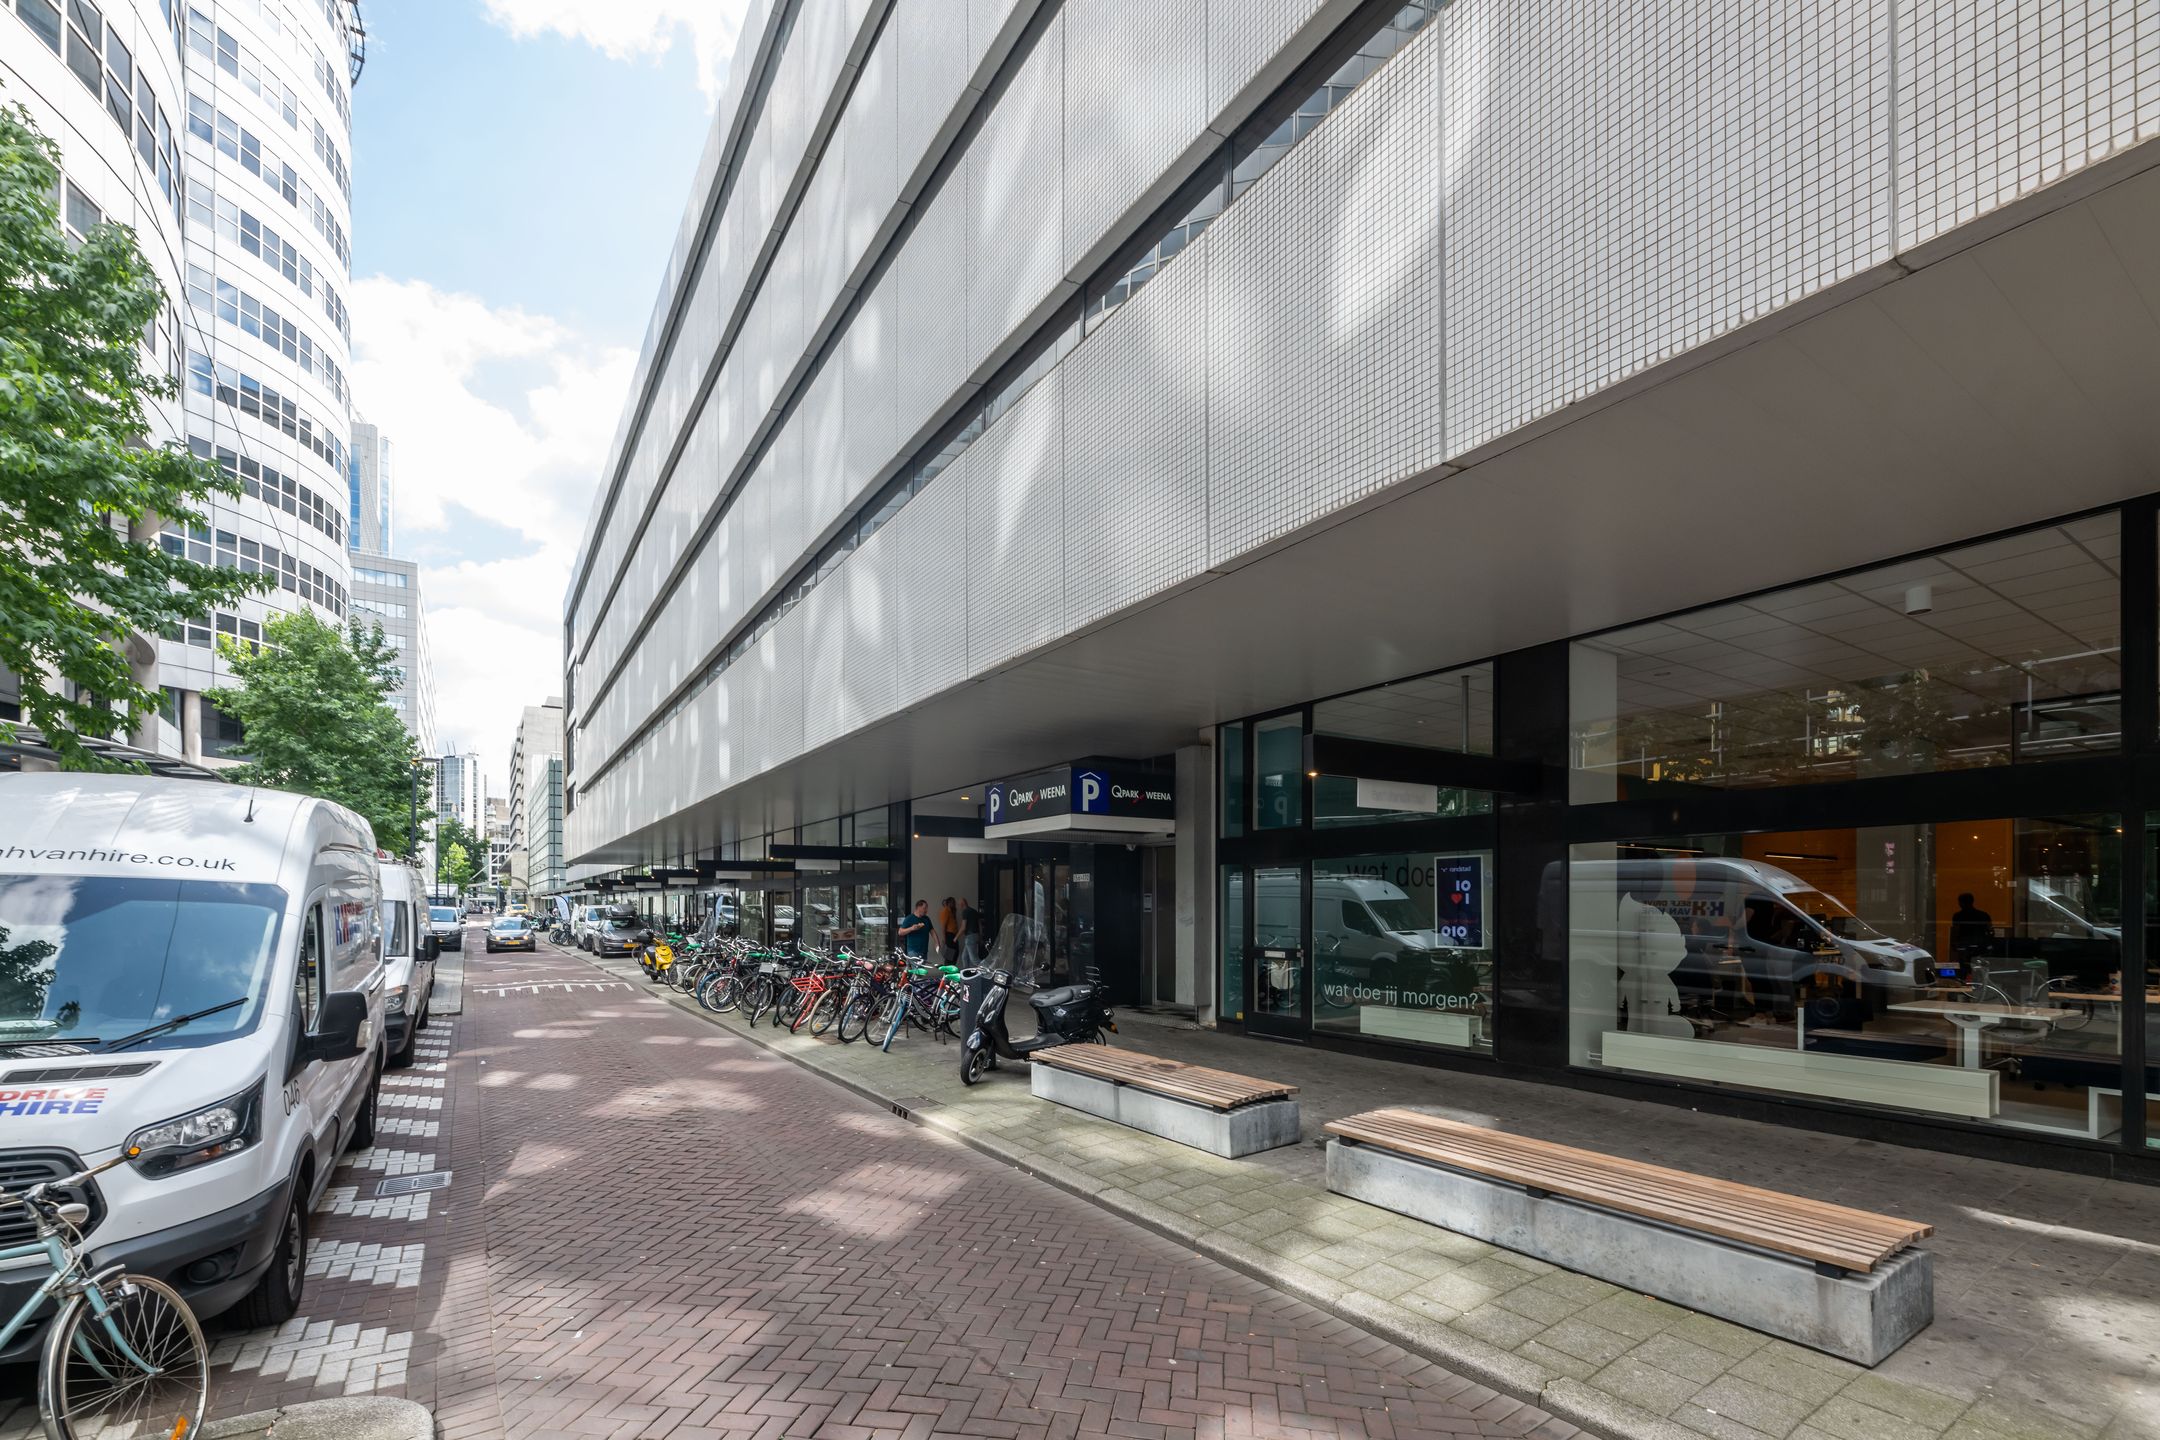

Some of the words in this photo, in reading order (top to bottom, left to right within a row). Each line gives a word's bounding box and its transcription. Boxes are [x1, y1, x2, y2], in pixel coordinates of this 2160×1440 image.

[1040, 784, 1066, 800] WEENA
[1082, 778, 1100, 812] P
[1145, 791, 1172, 801] WEENA
[990, 793, 1000, 823] P
[1324, 983, 1349, 997] wat
[1352, 982, 1381, 1000] doe
[1384, 985, 1398, 1006] jij
[1403, 990, 1479, 1011] morgen?
[283, 1079, 300, 1116] 046
